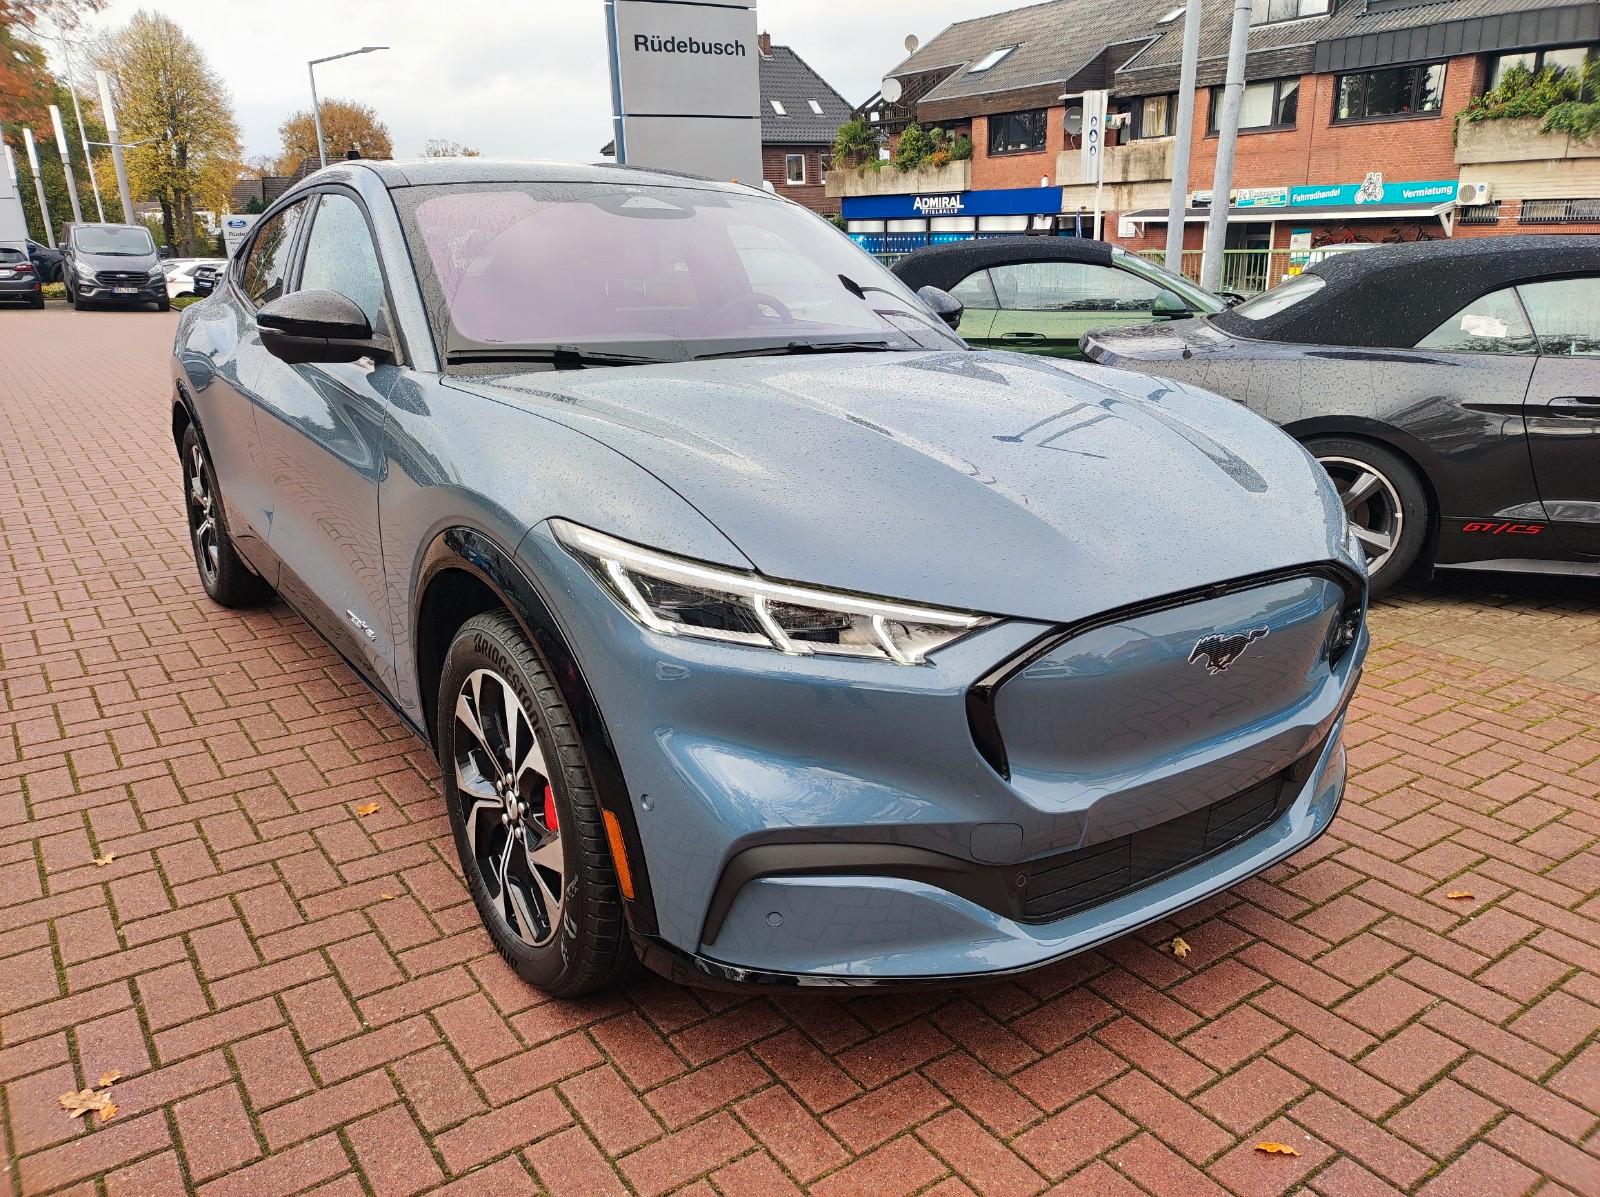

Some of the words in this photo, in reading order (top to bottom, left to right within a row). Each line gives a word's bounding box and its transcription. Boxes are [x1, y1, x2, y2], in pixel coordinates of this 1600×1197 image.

[634, 34, 746, 57] Rüdebusch
[1292, 187, 1341, 203] Fahrradhandel
[1402, 185, 1454, 199] Vermietung
[913, 194, 965, 210] ADMIRAL
[1461, 522, 1546, 535] GT/CS
